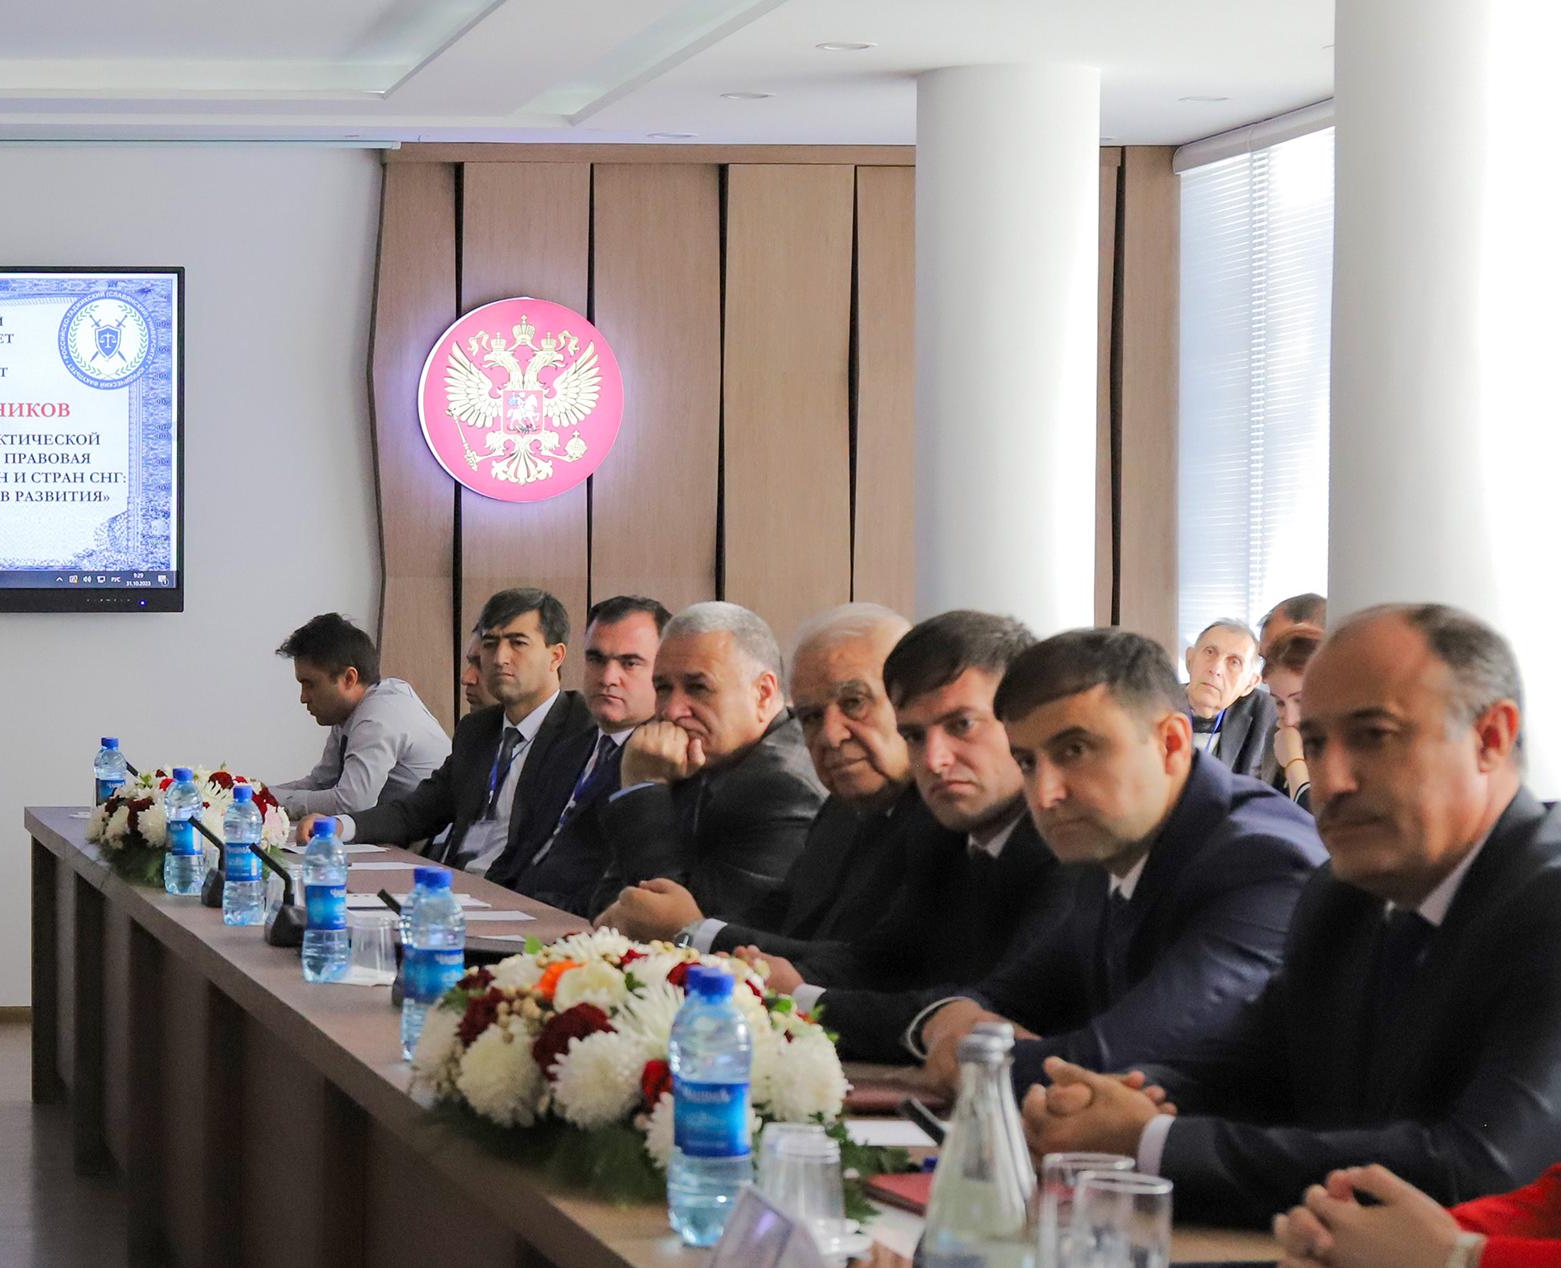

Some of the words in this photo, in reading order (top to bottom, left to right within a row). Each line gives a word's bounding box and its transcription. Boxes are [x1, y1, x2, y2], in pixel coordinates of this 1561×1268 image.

[4, 452, 91, 465] ПРАВОВАЯ
[14, 472, 26, 484] И
[30, 472, 85, 484] СТРАН
[89, 472, 127, 484] СНГ:
[15, 490, 110, 502] РАЗВИТИЯ»
